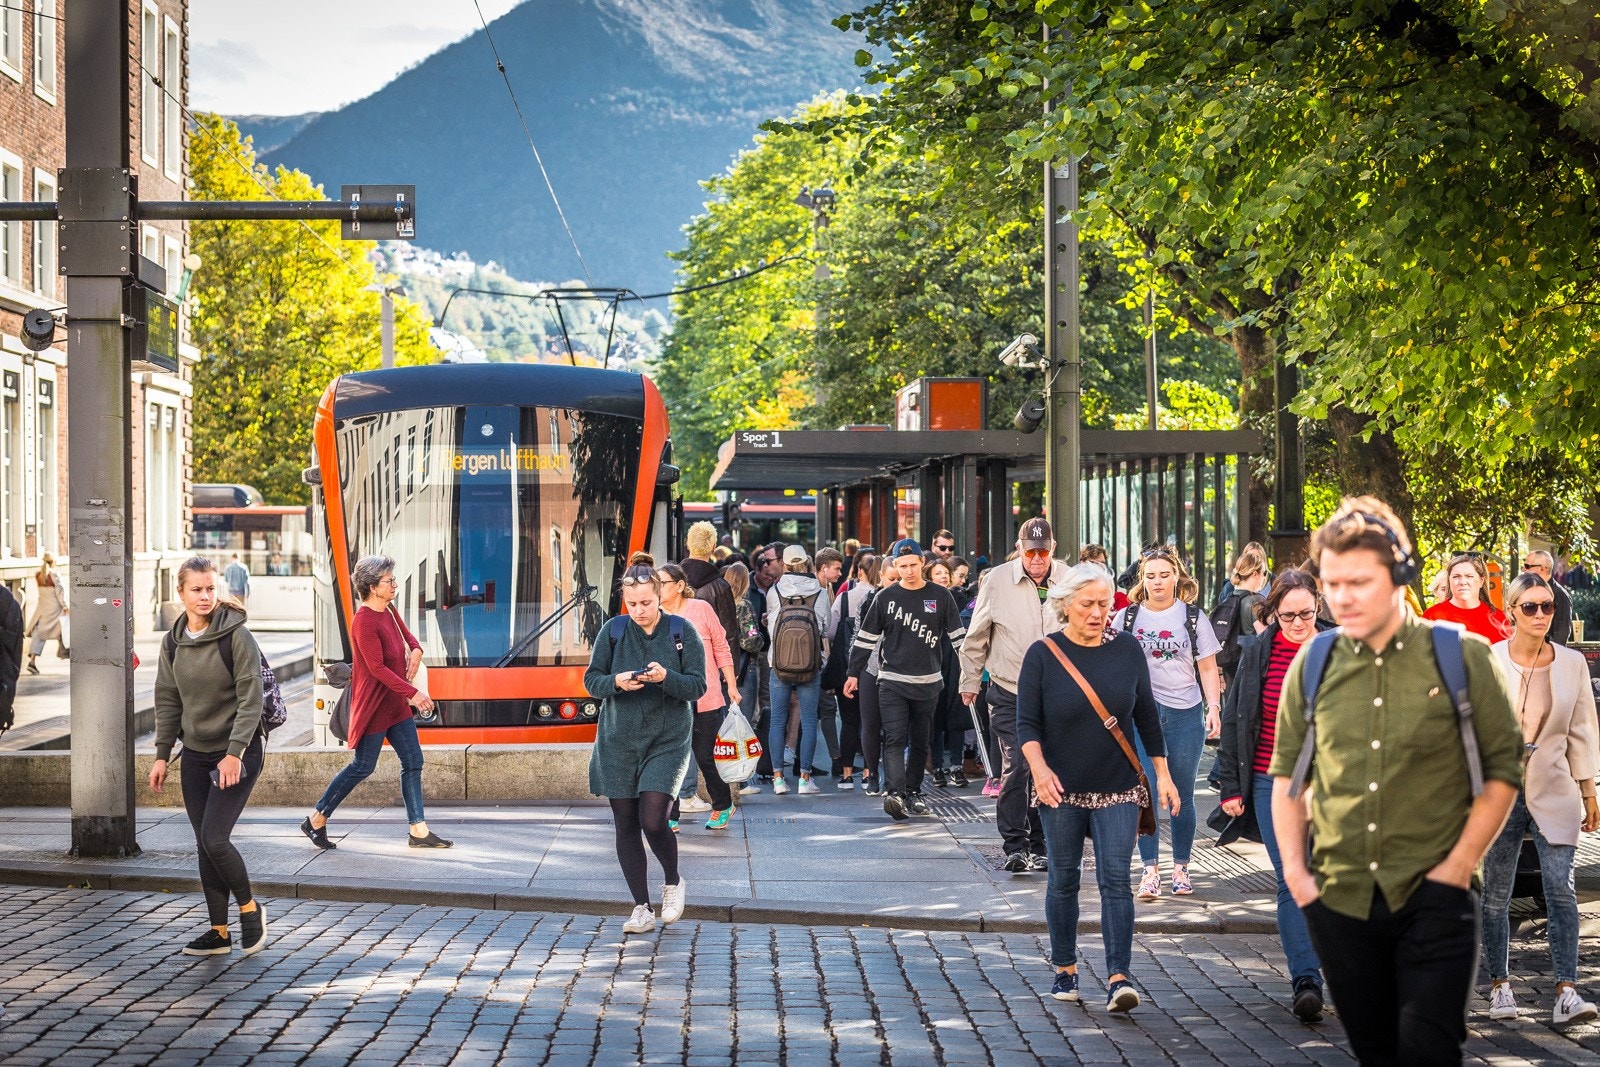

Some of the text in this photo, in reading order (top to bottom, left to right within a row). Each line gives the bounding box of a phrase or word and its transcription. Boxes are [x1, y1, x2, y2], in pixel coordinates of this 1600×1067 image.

[742, 431, 783, 448] Spor 1
[442, 449, 498, 476] Bergen
[887, 601, 939, 649] RANGERS
[1141, 640, 1189, 650] OTHING
